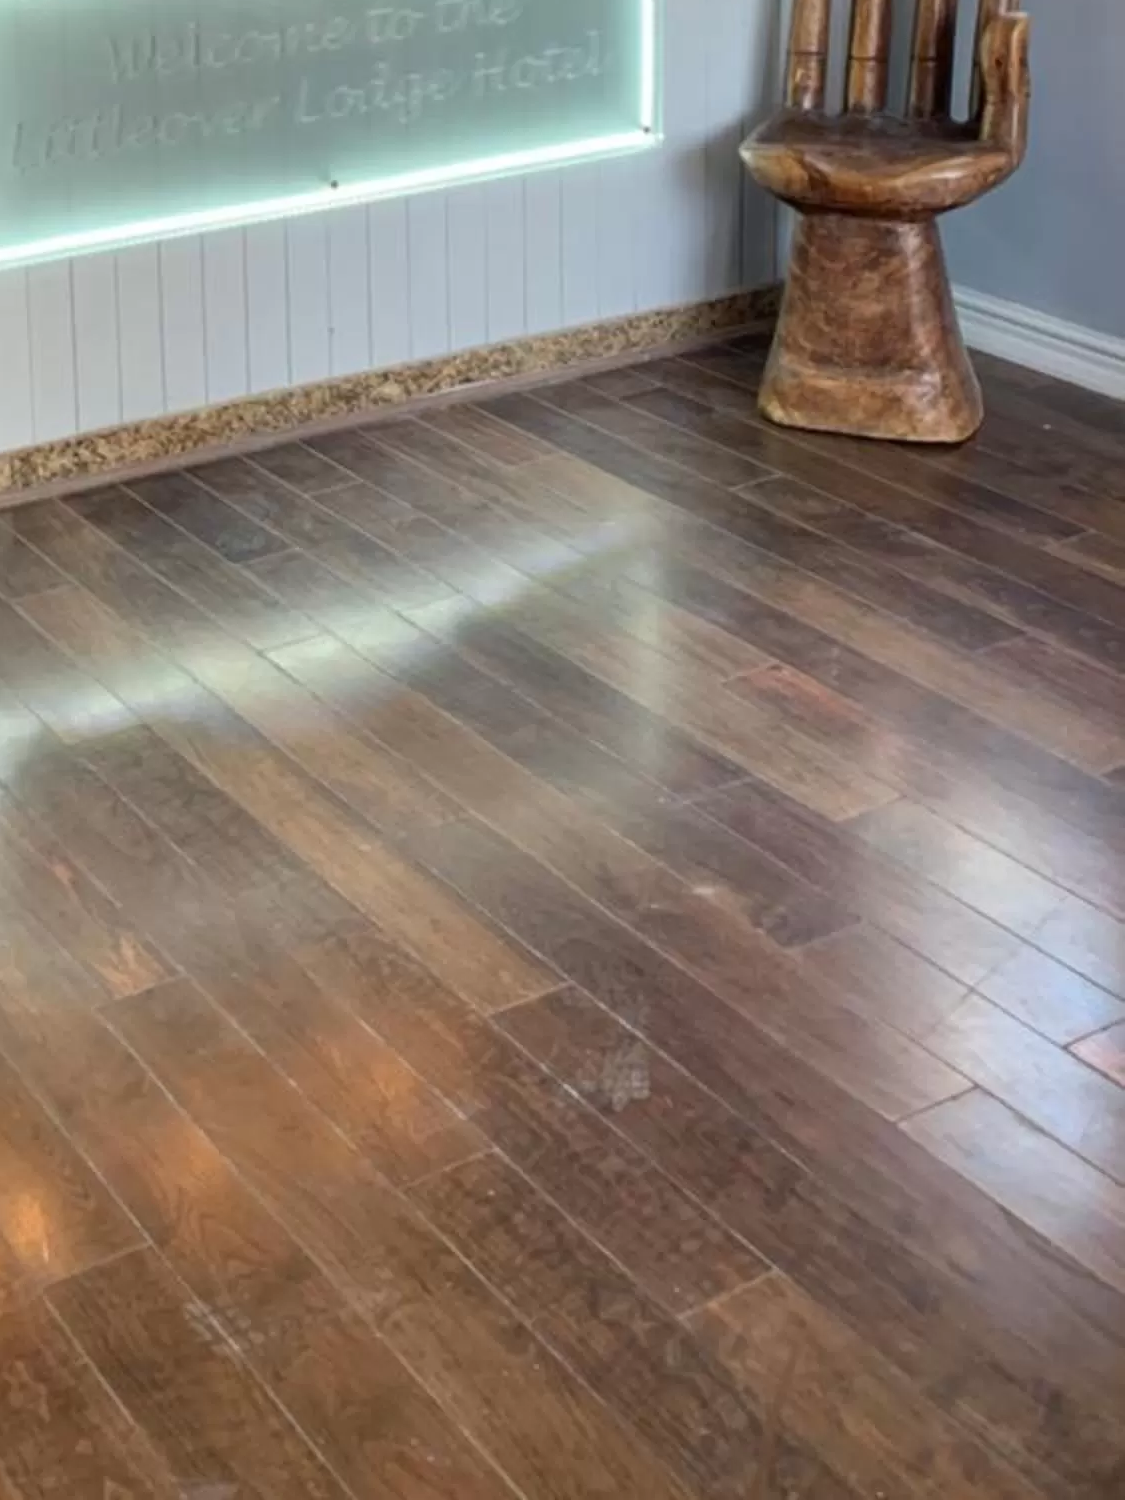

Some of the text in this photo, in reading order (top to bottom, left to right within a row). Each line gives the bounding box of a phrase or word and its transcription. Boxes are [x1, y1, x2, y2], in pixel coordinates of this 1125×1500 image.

[108, 21, 352, 84] Welcome
[364, 4, 425, 44] to
[11, 28, 608, 175] Littleover Lodge Hotel
